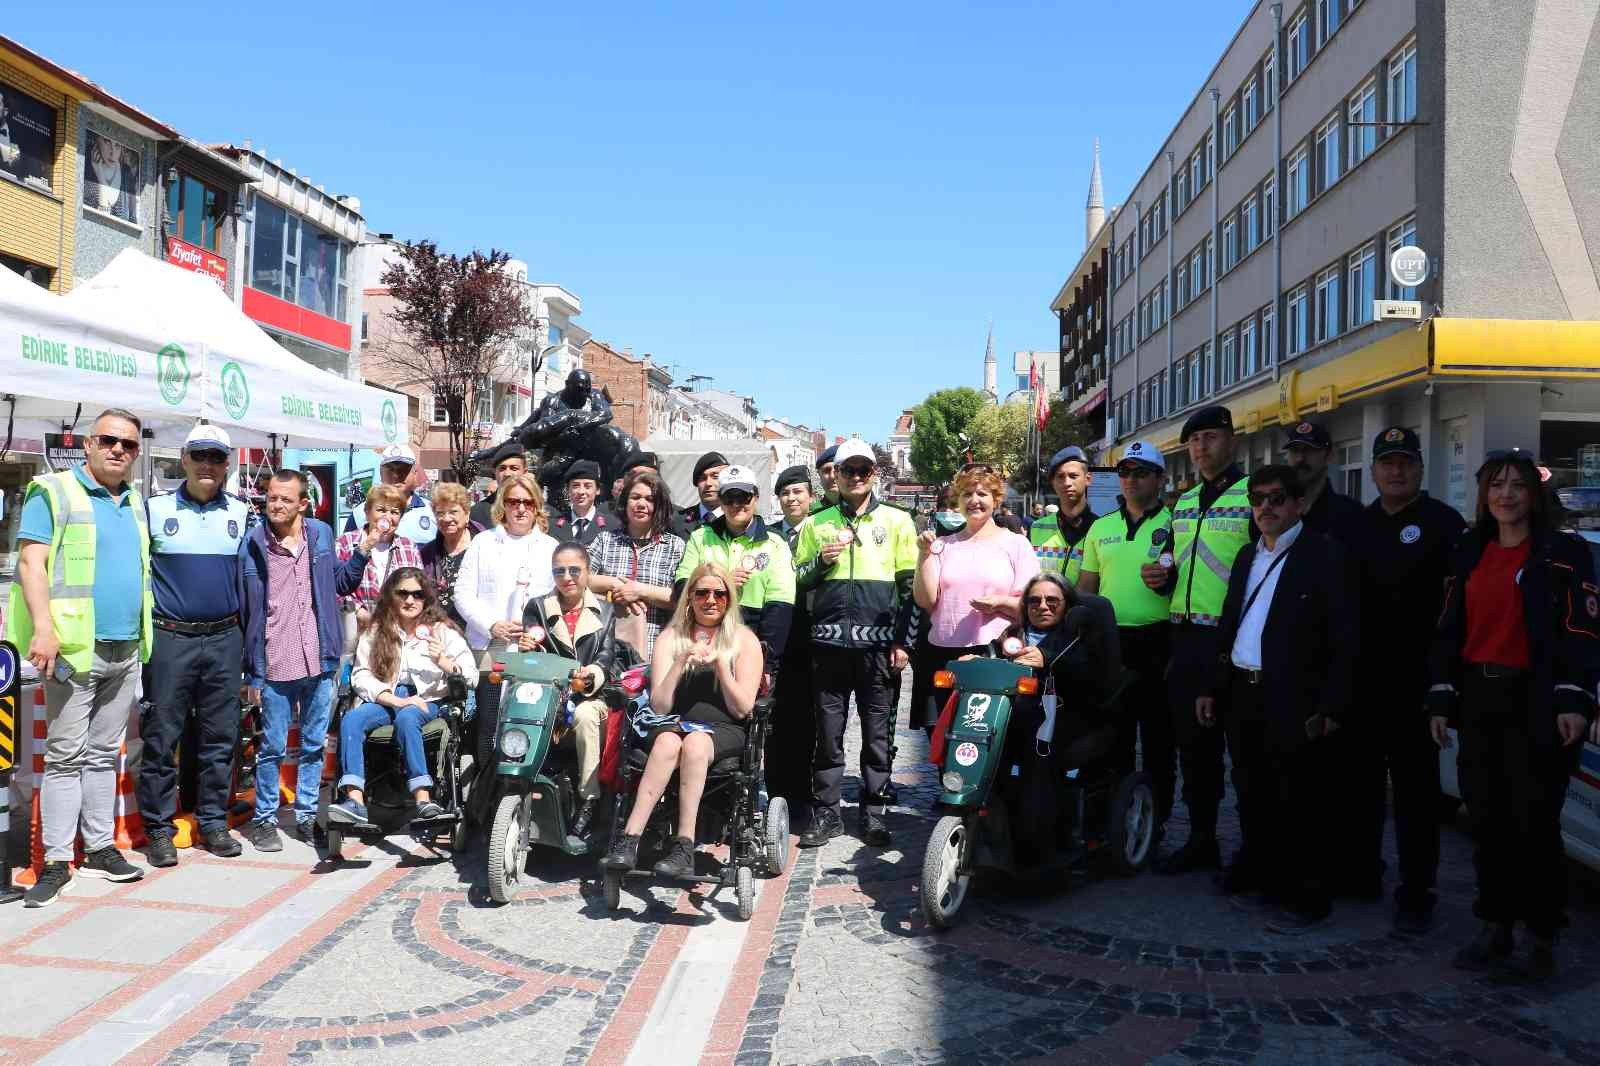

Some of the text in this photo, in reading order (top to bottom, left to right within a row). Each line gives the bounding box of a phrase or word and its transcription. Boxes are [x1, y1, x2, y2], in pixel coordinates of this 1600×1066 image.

[171, 242, 202, 266] Ziyafet
[1397, 258, 1425, 271] UPT
[22, 334, 138, 378] EDİRNE BELEDİYESİ
[281, 394, 361, 426] EDİRNE BELEDİYESİ
